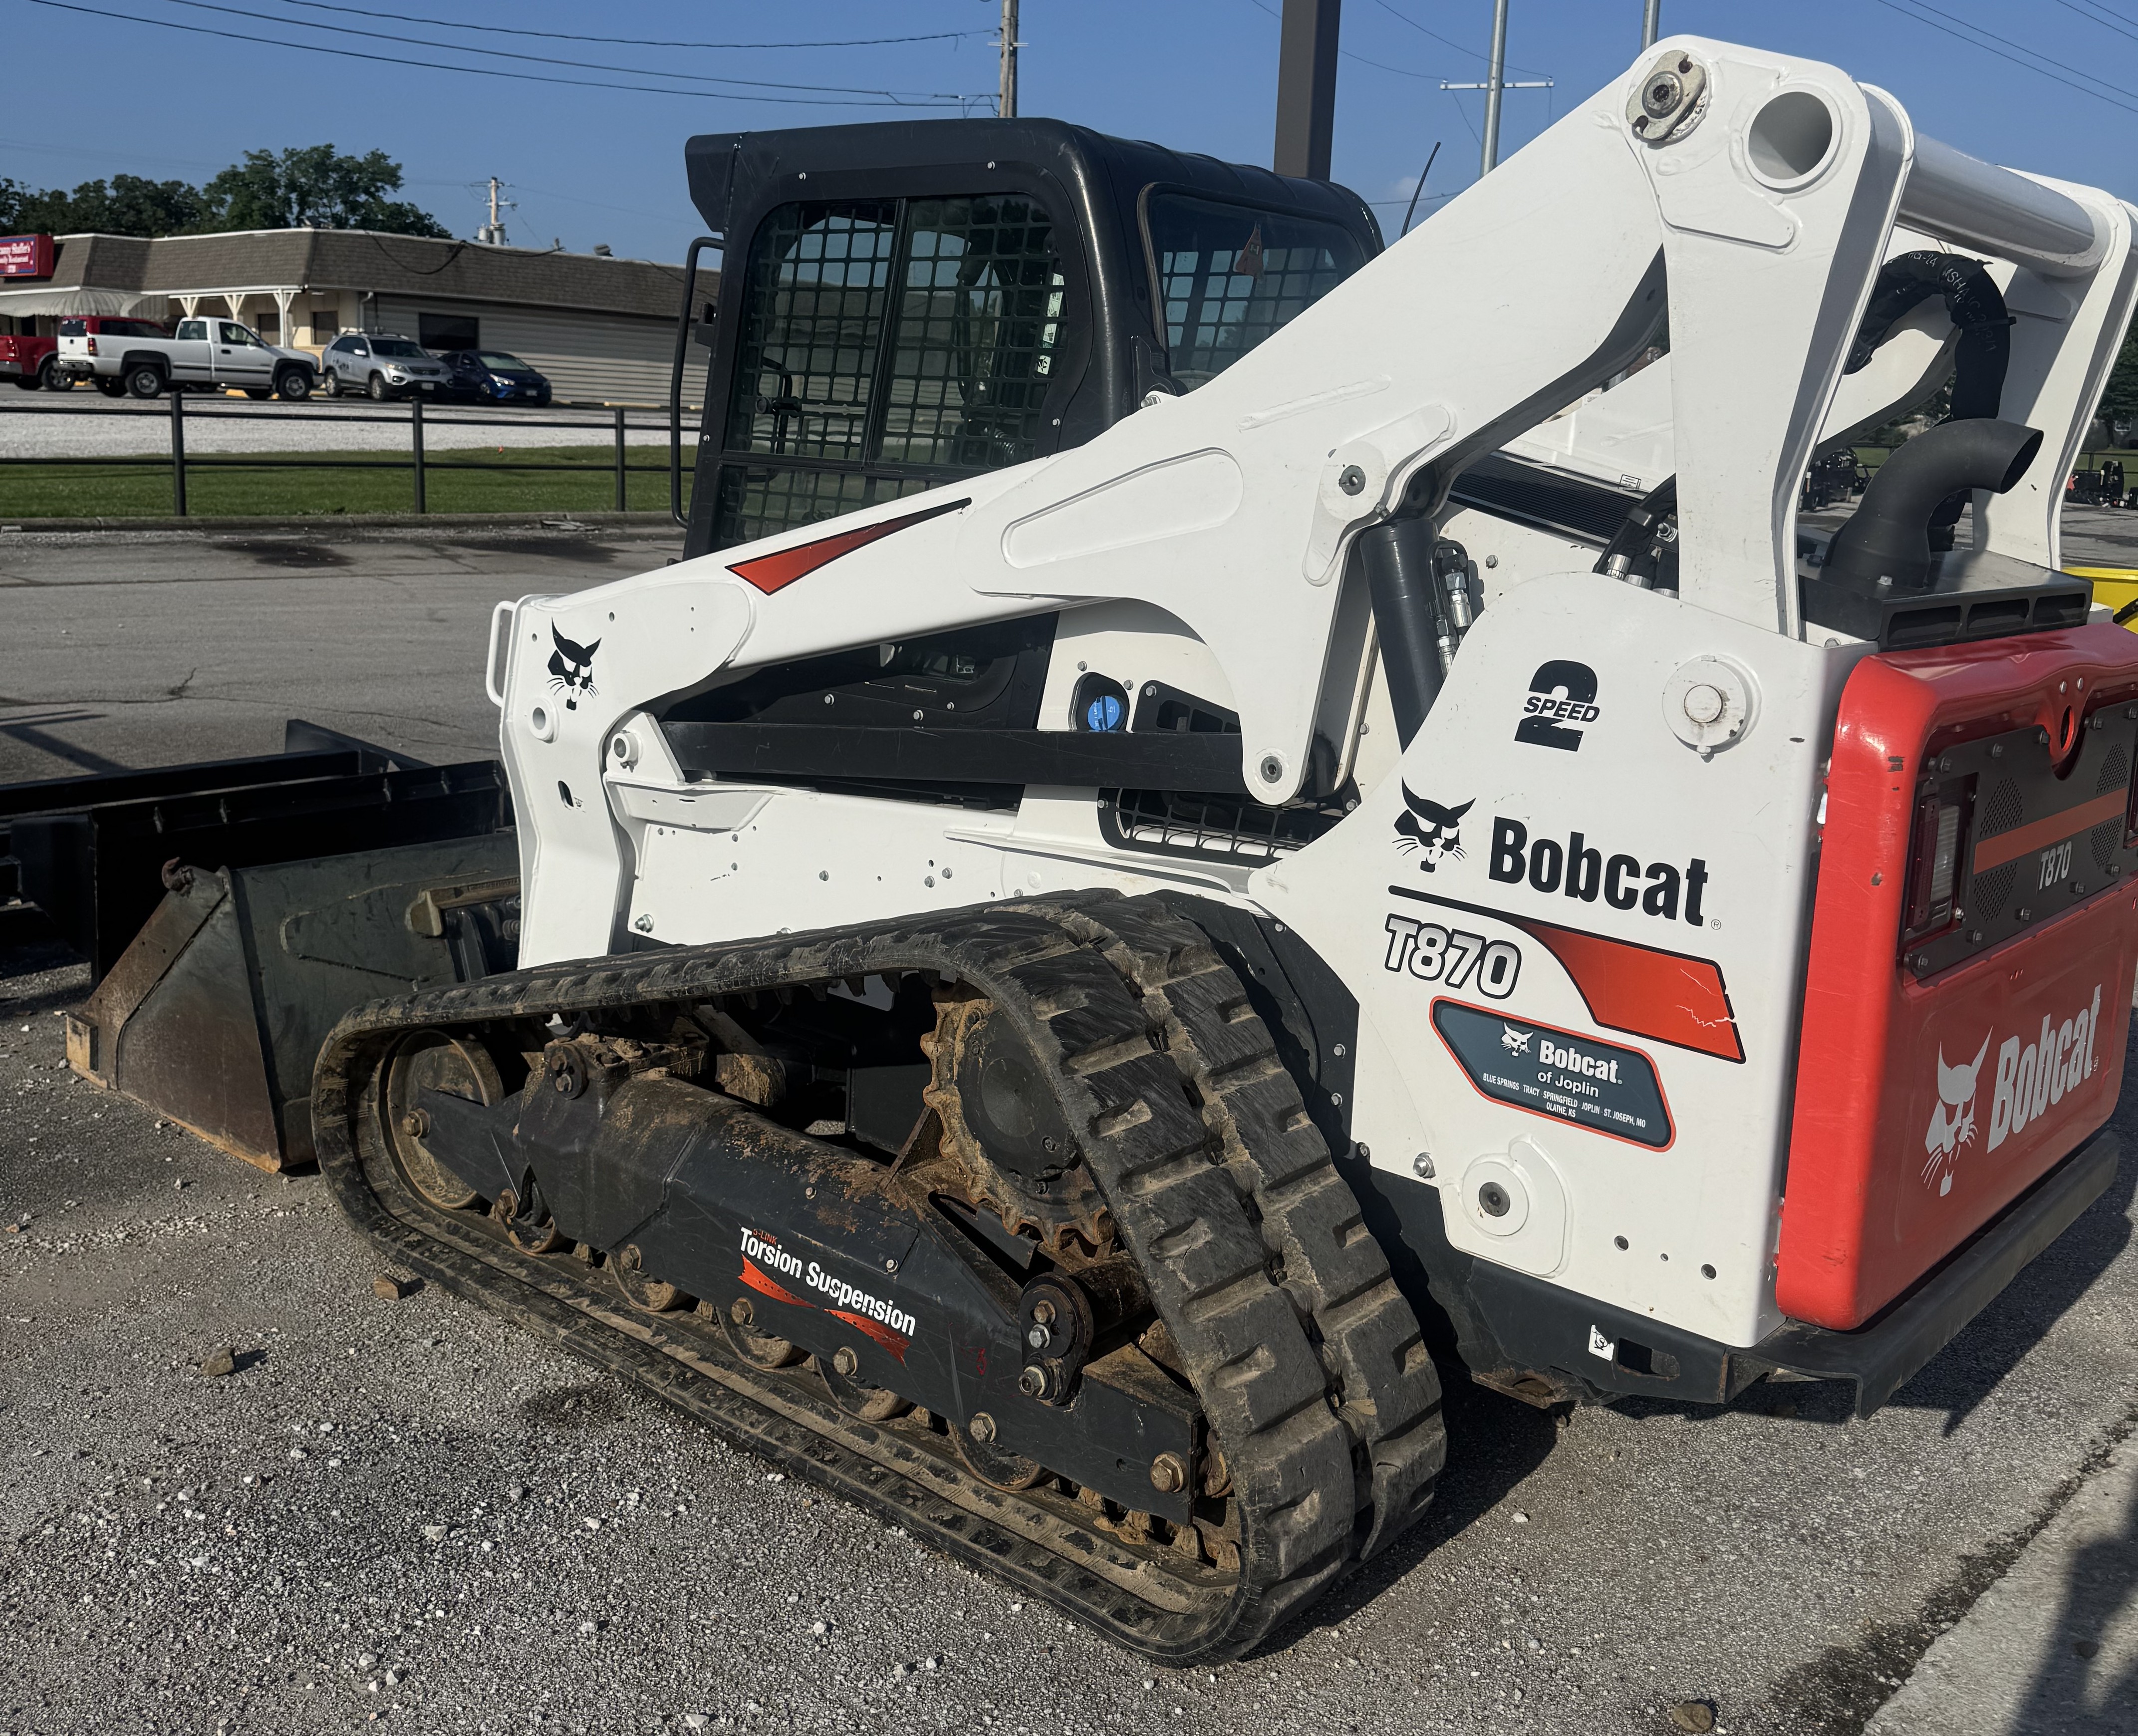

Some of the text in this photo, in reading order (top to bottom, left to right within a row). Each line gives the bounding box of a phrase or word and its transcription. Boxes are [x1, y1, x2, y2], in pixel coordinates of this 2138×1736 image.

[1514, 660, 1598, 752] 2
[1524, 696, 1600, 722] SPEED
[1489, 816, 1708, 927] Bobcat
[2039, 841, 2072, 890] T870
[1385, 913, 1522, 1000] T870
[1538, 1072, 1599, 1098] of Joplin
[1539, 1040, 1618, 1083] Bobcat
[1987, 984, 2102, 1154] Bobcat
[1483, 1073, 1646, 1128] BLUE SPRINGS TRACY SPRINGFIELD JOPLIN ST. JOSEPH, MO
[1546, 1102, 1576, 1118] OLATHE, KS
[753, 1228, 778, 1245] 5-LINK
[741, 1227, 916, 1336] Torsion Suspension
